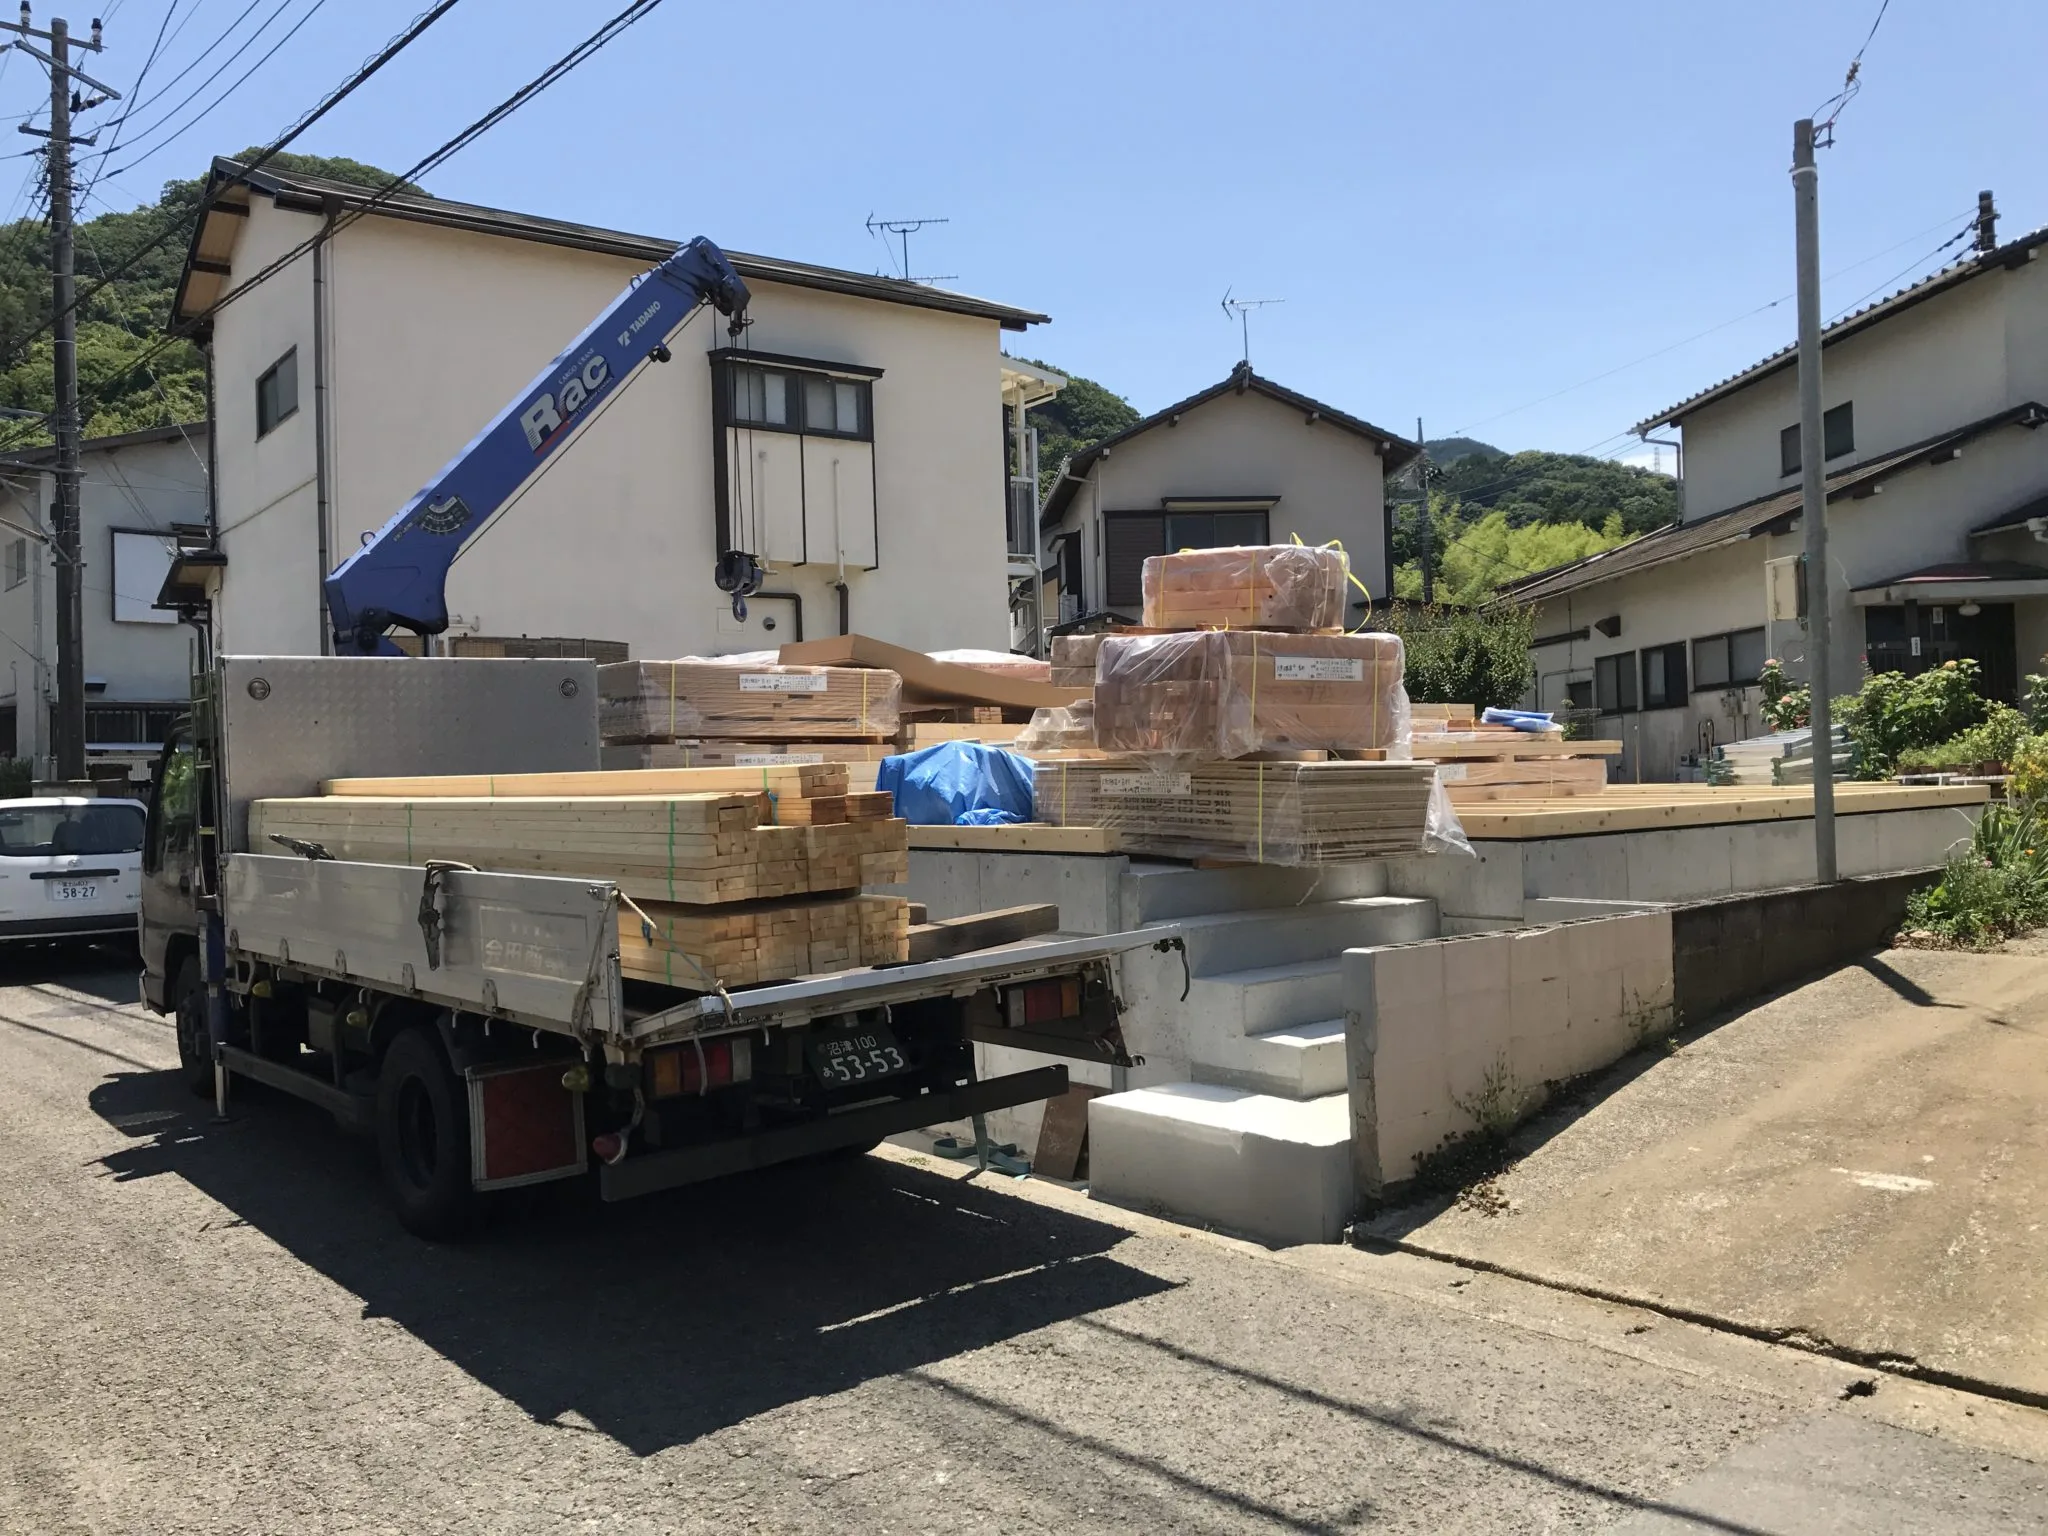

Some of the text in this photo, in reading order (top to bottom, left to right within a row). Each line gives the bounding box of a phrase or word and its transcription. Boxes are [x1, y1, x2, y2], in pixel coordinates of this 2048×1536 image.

[629, 301, 661, 334] TADANO
[519, 355, 610, 452] Rac
[62, 886, 96, 899] 58-27
[831, 1047, 904, 1081] 53-53
